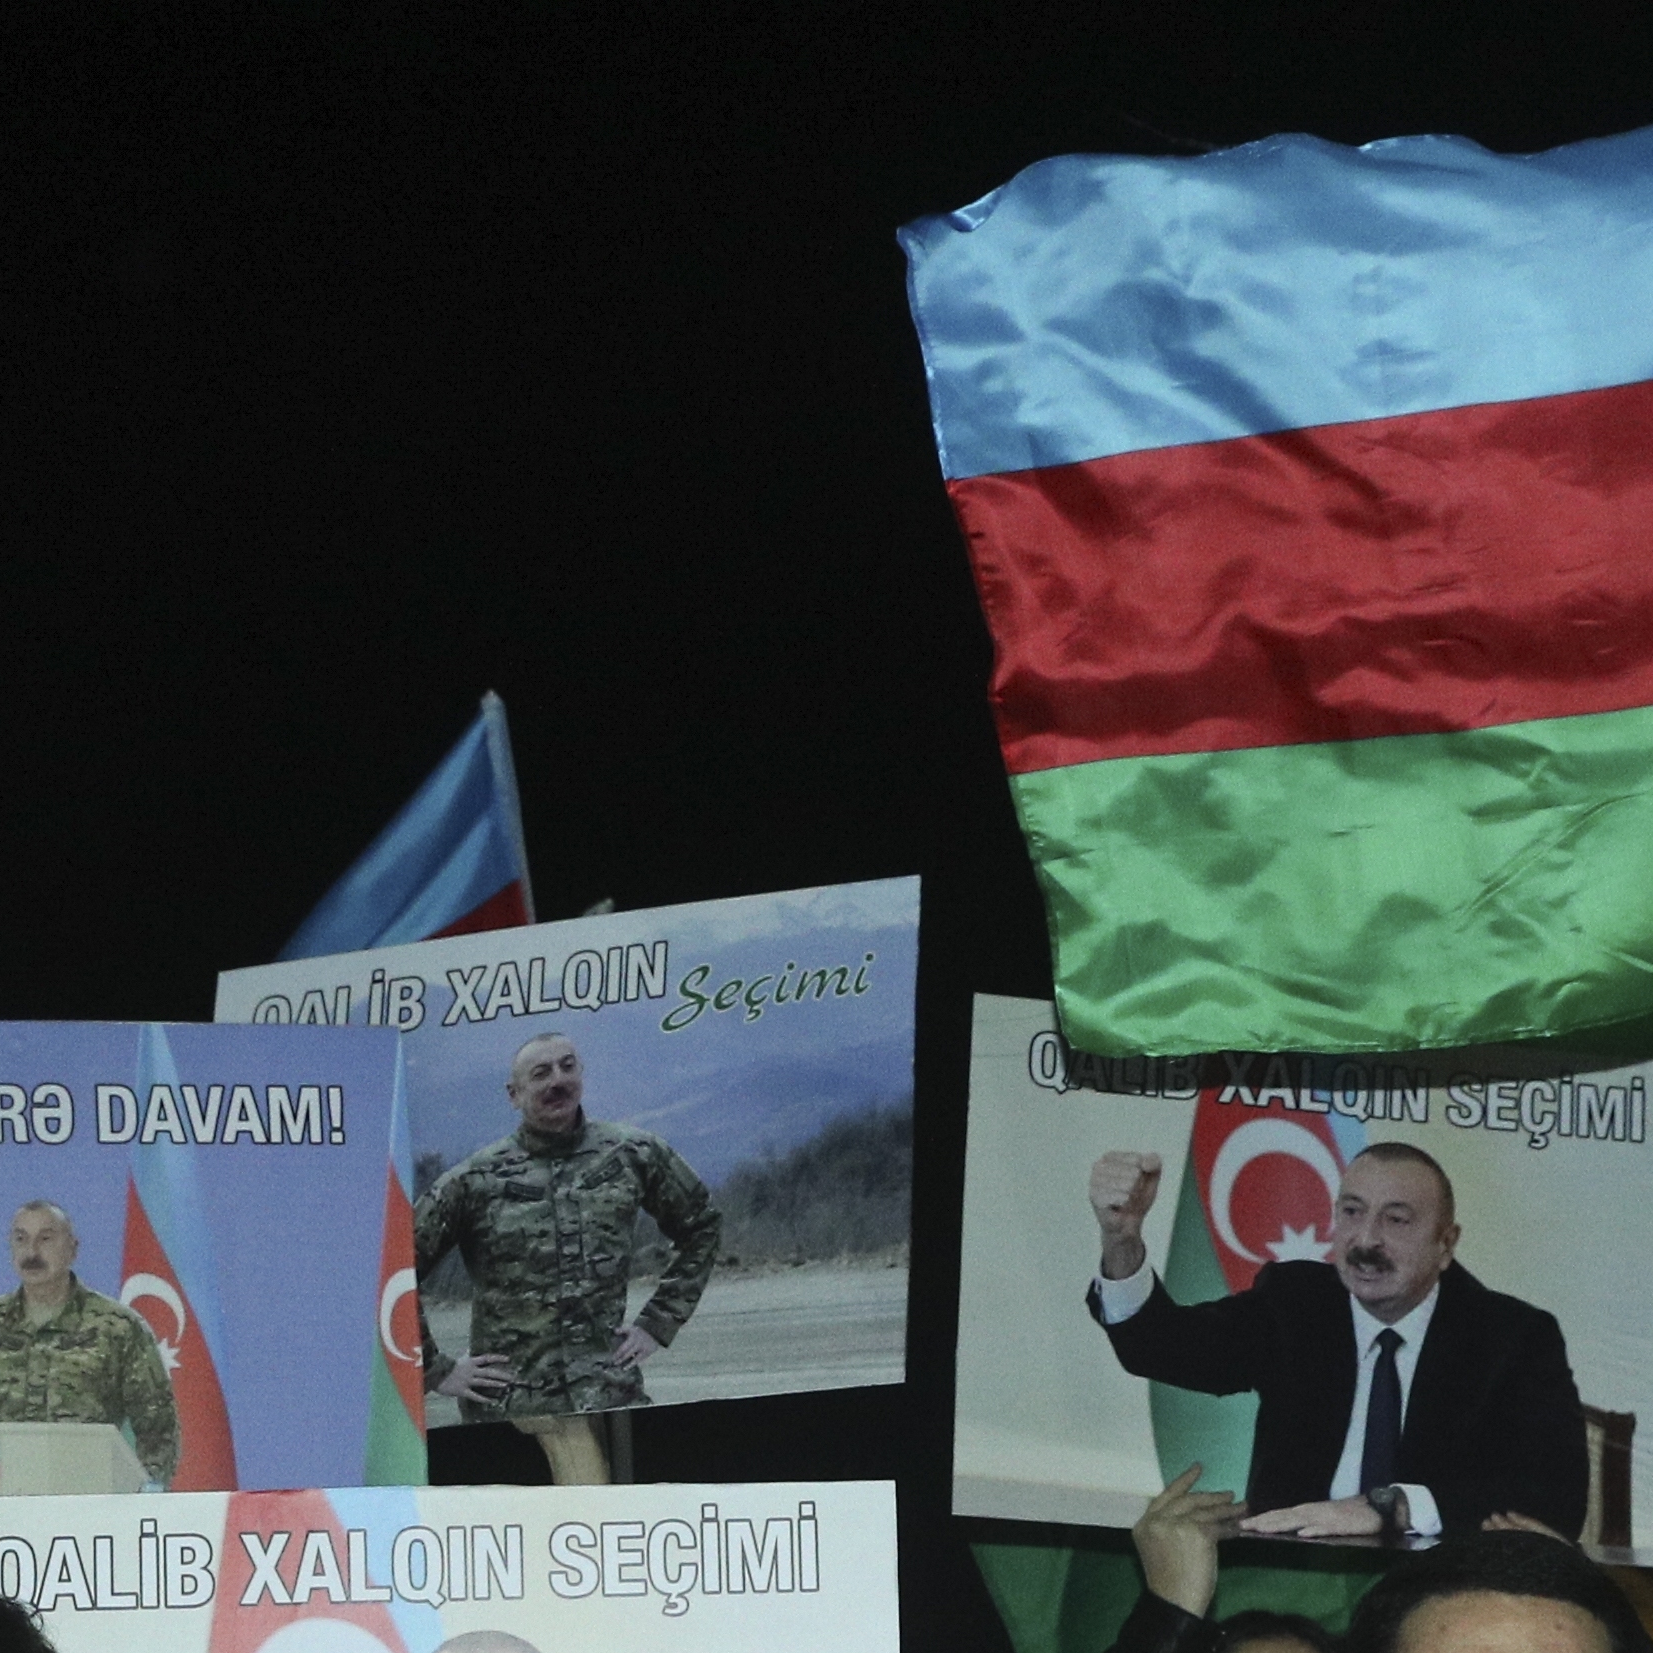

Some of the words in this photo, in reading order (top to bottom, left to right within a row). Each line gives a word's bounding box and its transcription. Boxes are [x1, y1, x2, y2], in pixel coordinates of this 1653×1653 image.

[442, 940, 668, 1026] XALQIN
[659, 951, 876, 1033] Seçimi
[96, 1083, 347, 1146] DAVAM!
[1217, 1051, 1429, 1123] XALQIN
[1446, 1071, 1646, 1150] SEÇİMİ
[239, 1523, 525, 1610] XALQIN
[546, 1500, 821, 1616] SEÇİMİ
